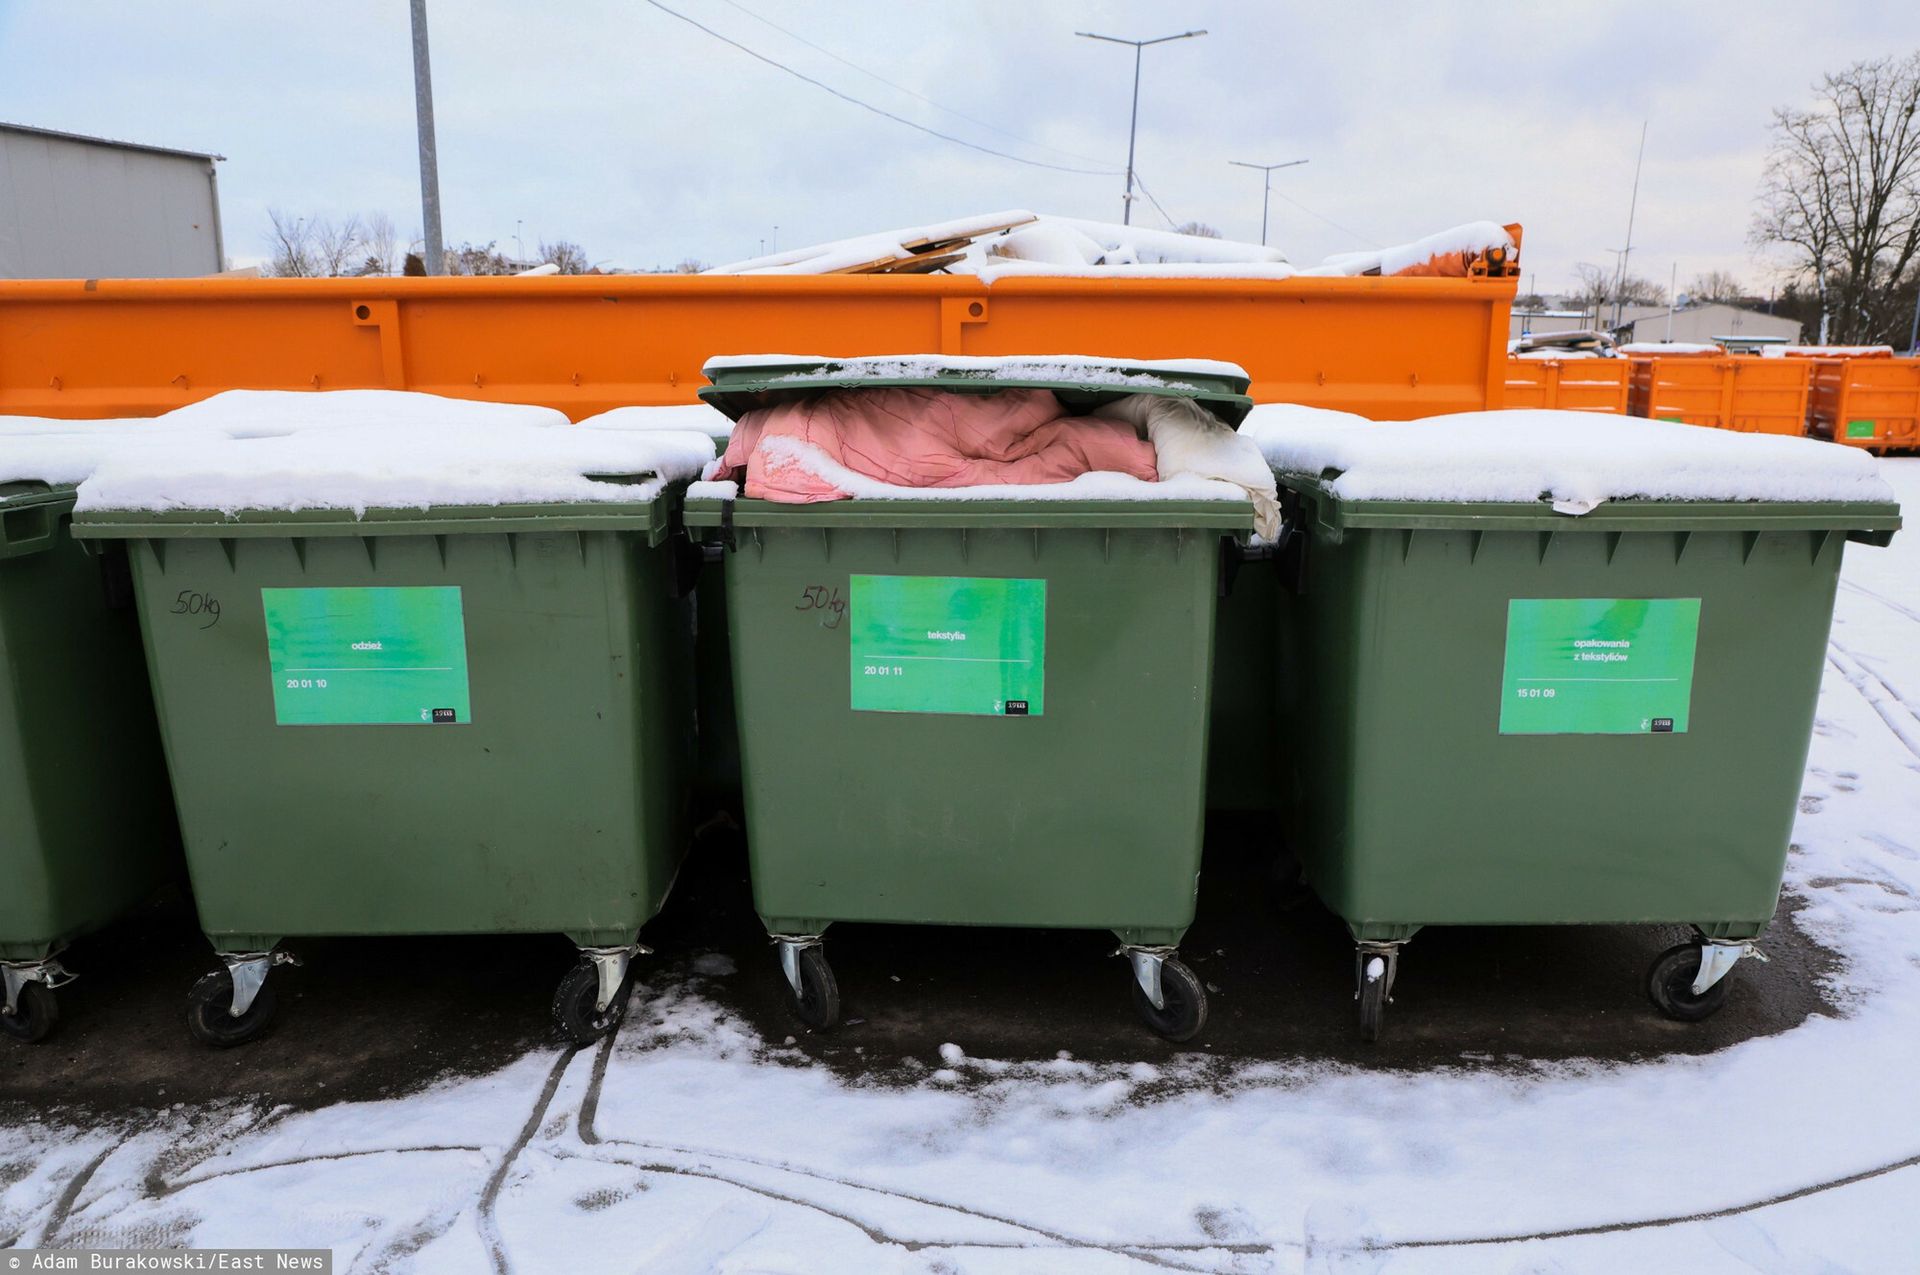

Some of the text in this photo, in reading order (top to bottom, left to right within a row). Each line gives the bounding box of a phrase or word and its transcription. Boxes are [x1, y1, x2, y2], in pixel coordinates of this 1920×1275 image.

[927, 630, 966, 641] tekstylia
[351, 640, 383, 651] odzież
[1573, 639, 1630, 649] opakowania
[1573, 652, 1629, 662] z tekstyliów
[864, 666, 903, 676] 20 01 11
[286, 679, 328, 689] 20 01 10
[1517, 688, 1556, 698] 15 01 09
